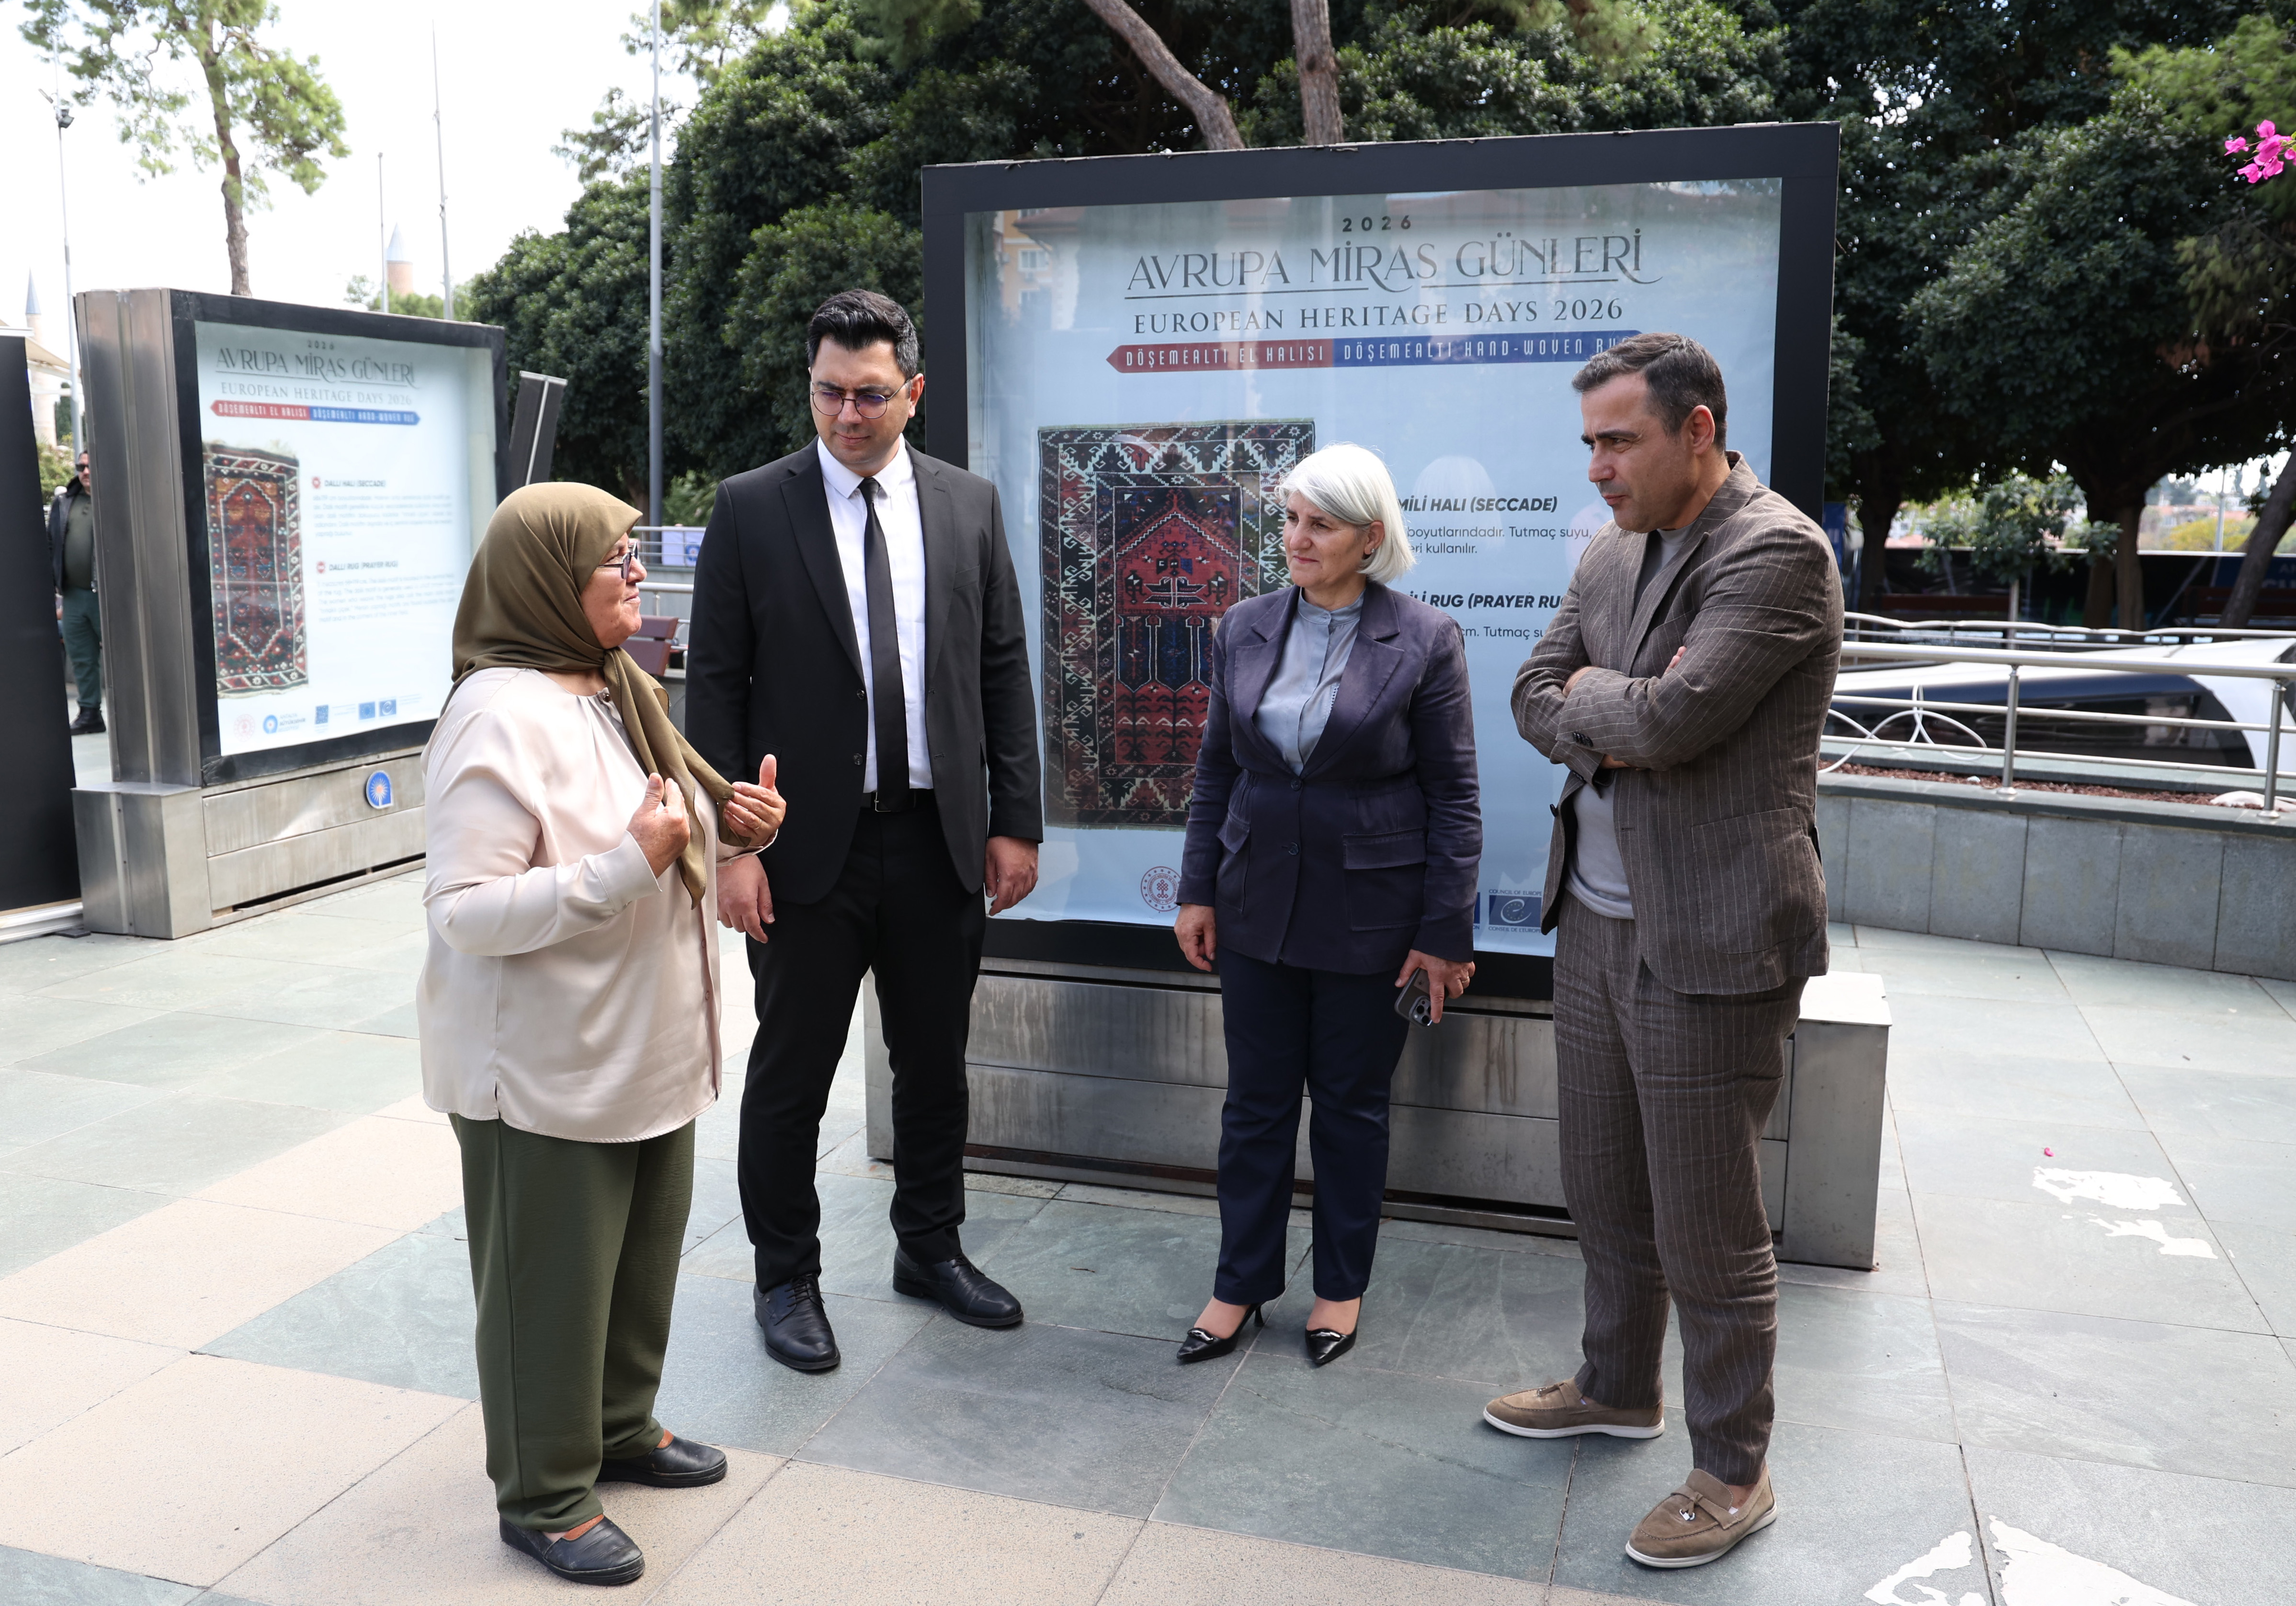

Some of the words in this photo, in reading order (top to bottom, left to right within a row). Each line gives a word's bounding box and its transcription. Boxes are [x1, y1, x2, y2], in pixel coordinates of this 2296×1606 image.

[1342, 215, 1411, 232] 2026
[1127, 249, 1290, 290] AVRUPA
[1310, 240, 1437, 293] MİRAS
[1456, 228, 1663, 284] GÜNLERİ
[1135, 309, 1284, 333] EUROPEAN
[1299, 304, 1447, 328] HERITAGE
[1465, 301, 1537, 323] DAYS
[1554, 298, 1623, 321] 2026
[1126, 348, 1228, 368] DÖŞEMEALTI
[1239, 348, 1255, 363] EL
[1267, 345, 1323, 362] HALISI
[1344, 341, 1451, 362] DÖŞEMEALTI
[1465, 339, 1582, 356] HAND-WOVEN
[216, 348, 288, 373] AVRUPA
[295, 352, 346, 383] MİRAS
[352, 356, 421, 389] GÜNLERİ
[221, 382, 288, 398] EUROPEAN
[294, 387, 352, 403] HERITAGE
[357, 392, 383, 404] DAYS
[387, 394, 412, 406] 2026
[1398, 495, 1427, 511] MİLİ
[1430, 498, 1467, 511] HALI
[1470, 496, 1557, 513] (SECCADE)
[1408, 526, 1505, 540] boyutlarındadır.
[1509, 526, 1556, 540] Tutmaç
[1560, 528, 1592, 540] suyu,
[1426, 543, 1478, 554] kullanılır.
[1430, 594, 1464, 608] RUG
[1468, 593, 1535, 609] (PRAYER
[1538, 595, 1564, 608] RU
[1483, 626, 1530, 640] Tutmaç
